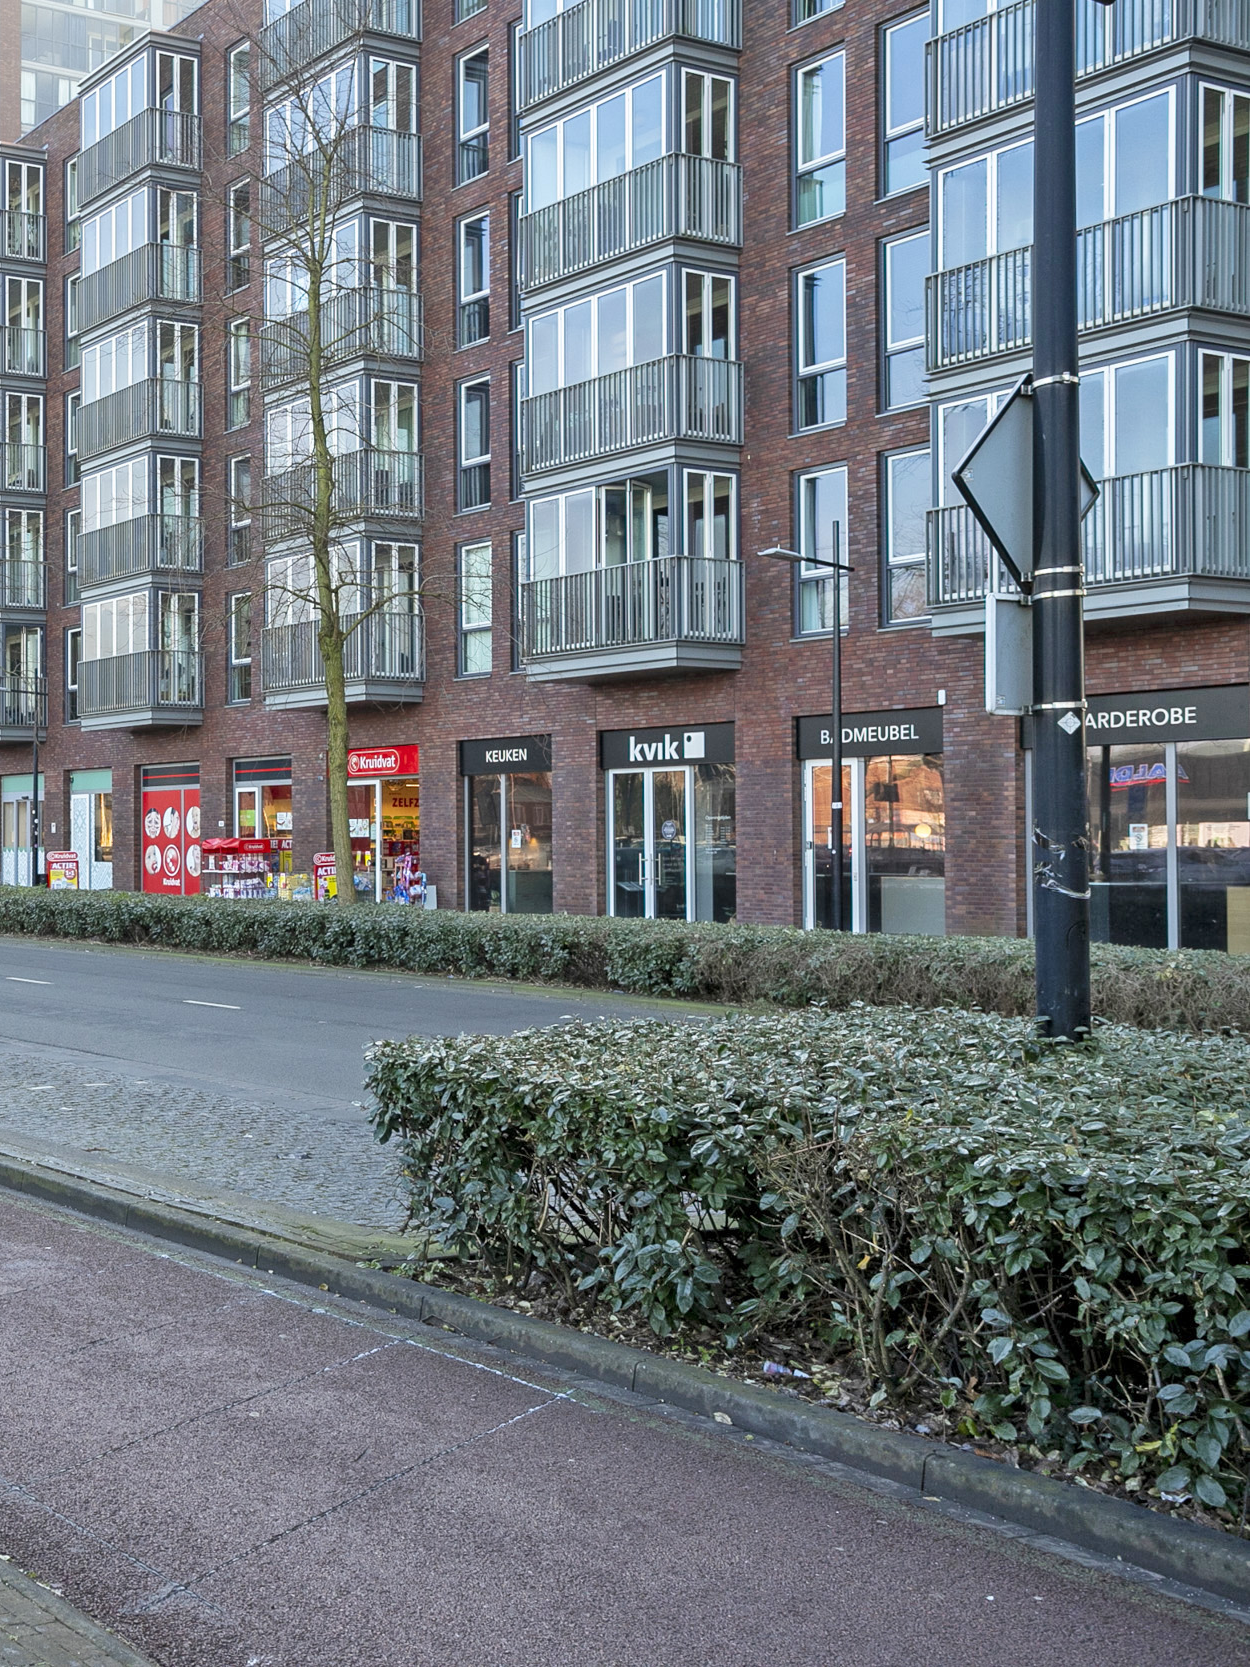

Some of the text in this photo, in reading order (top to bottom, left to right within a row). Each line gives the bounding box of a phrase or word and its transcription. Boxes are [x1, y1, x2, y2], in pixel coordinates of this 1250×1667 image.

[1085, 706, 1197, 729] ARDEROBE
[820, 724, 920, 744] BDMEUBEL
[485, 748, 527, 763] KEUKEN
[629, 734, 679, 762] kvik
[359, 754, 396, 770] Kruidvat
[392, 797, 419, 807] ZELFZ
